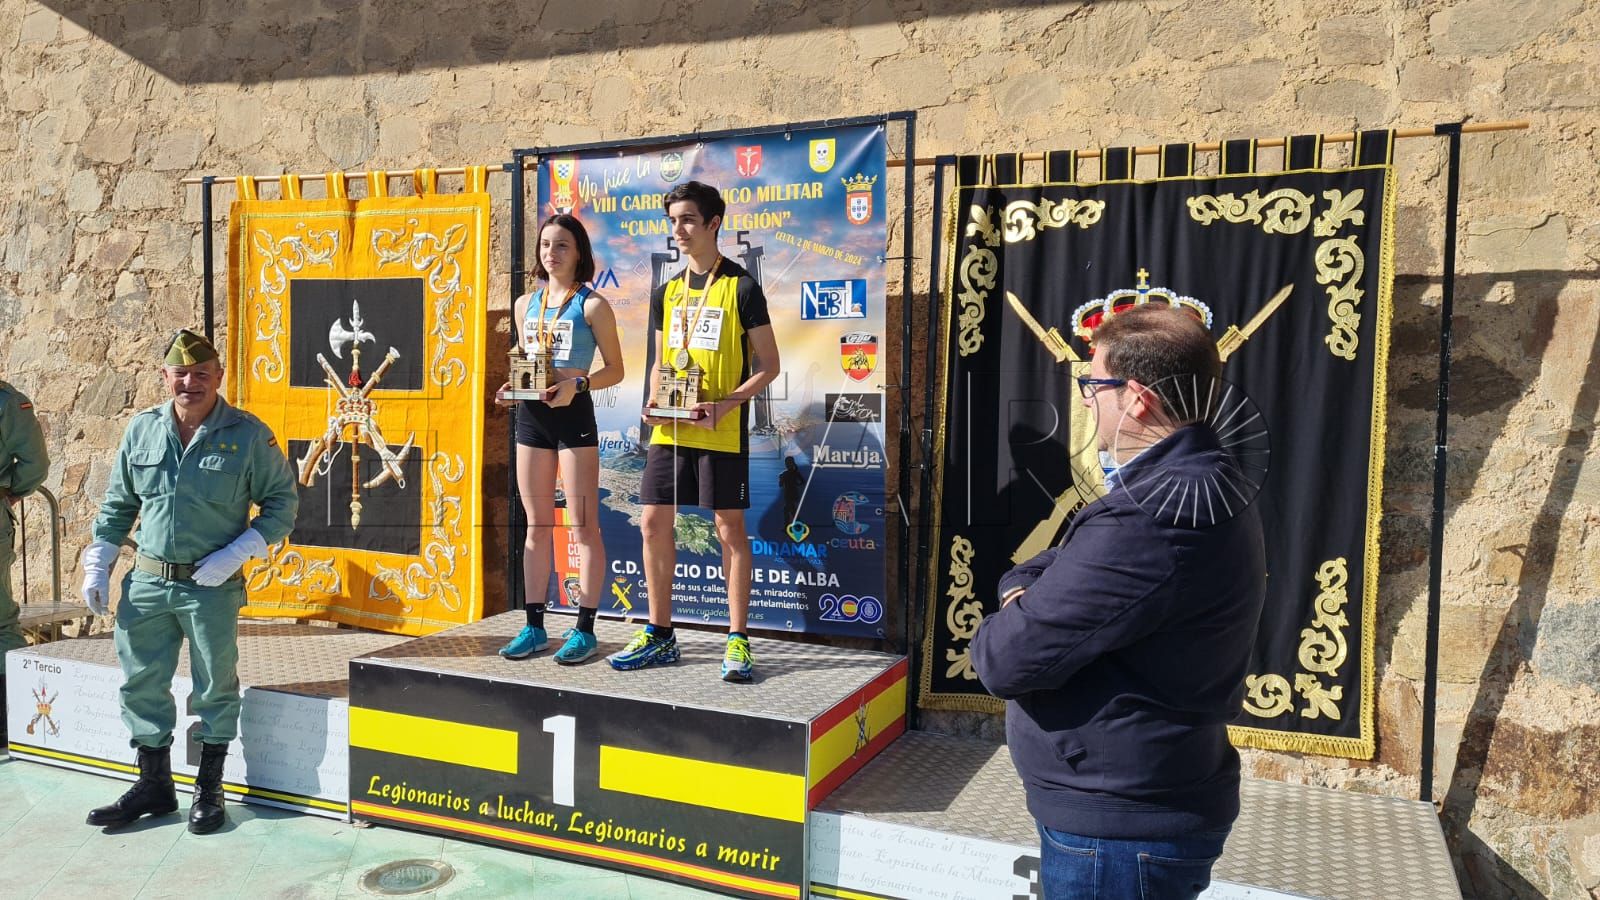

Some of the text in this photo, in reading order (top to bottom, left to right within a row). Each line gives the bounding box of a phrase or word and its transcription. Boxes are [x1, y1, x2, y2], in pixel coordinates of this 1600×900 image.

[578, 155, 651, 203] Yo hice la
[592, 196, 617, 213] VIII
[621, 192, 666, 211] CARR
[757, 182, 824, 203] MILITAR
[802, 241, 813, 254] DE
[812, 241, 834, 258] MARZO
[833, 249, 844, 260] DE
[844, 252, 863, 266] 2024
[812, 445, 880, 468] Maruja
[611, 560, 641, 575] C.D.
[768, 569, 790, 585] DE
[795, 571, 841, 588] ALBA
[671, 594, 699, 604] arques,
[687, 584, 701, 592] sus
[764, 589, 809, 600] miradores,
[818, 593, 883, 624] 200
[34, 660, 62, 674] Tercio
[543, 714, 576, 807] 1
[367, 775, 781, 871] Legionarios a luchar, Legionarios a morir
